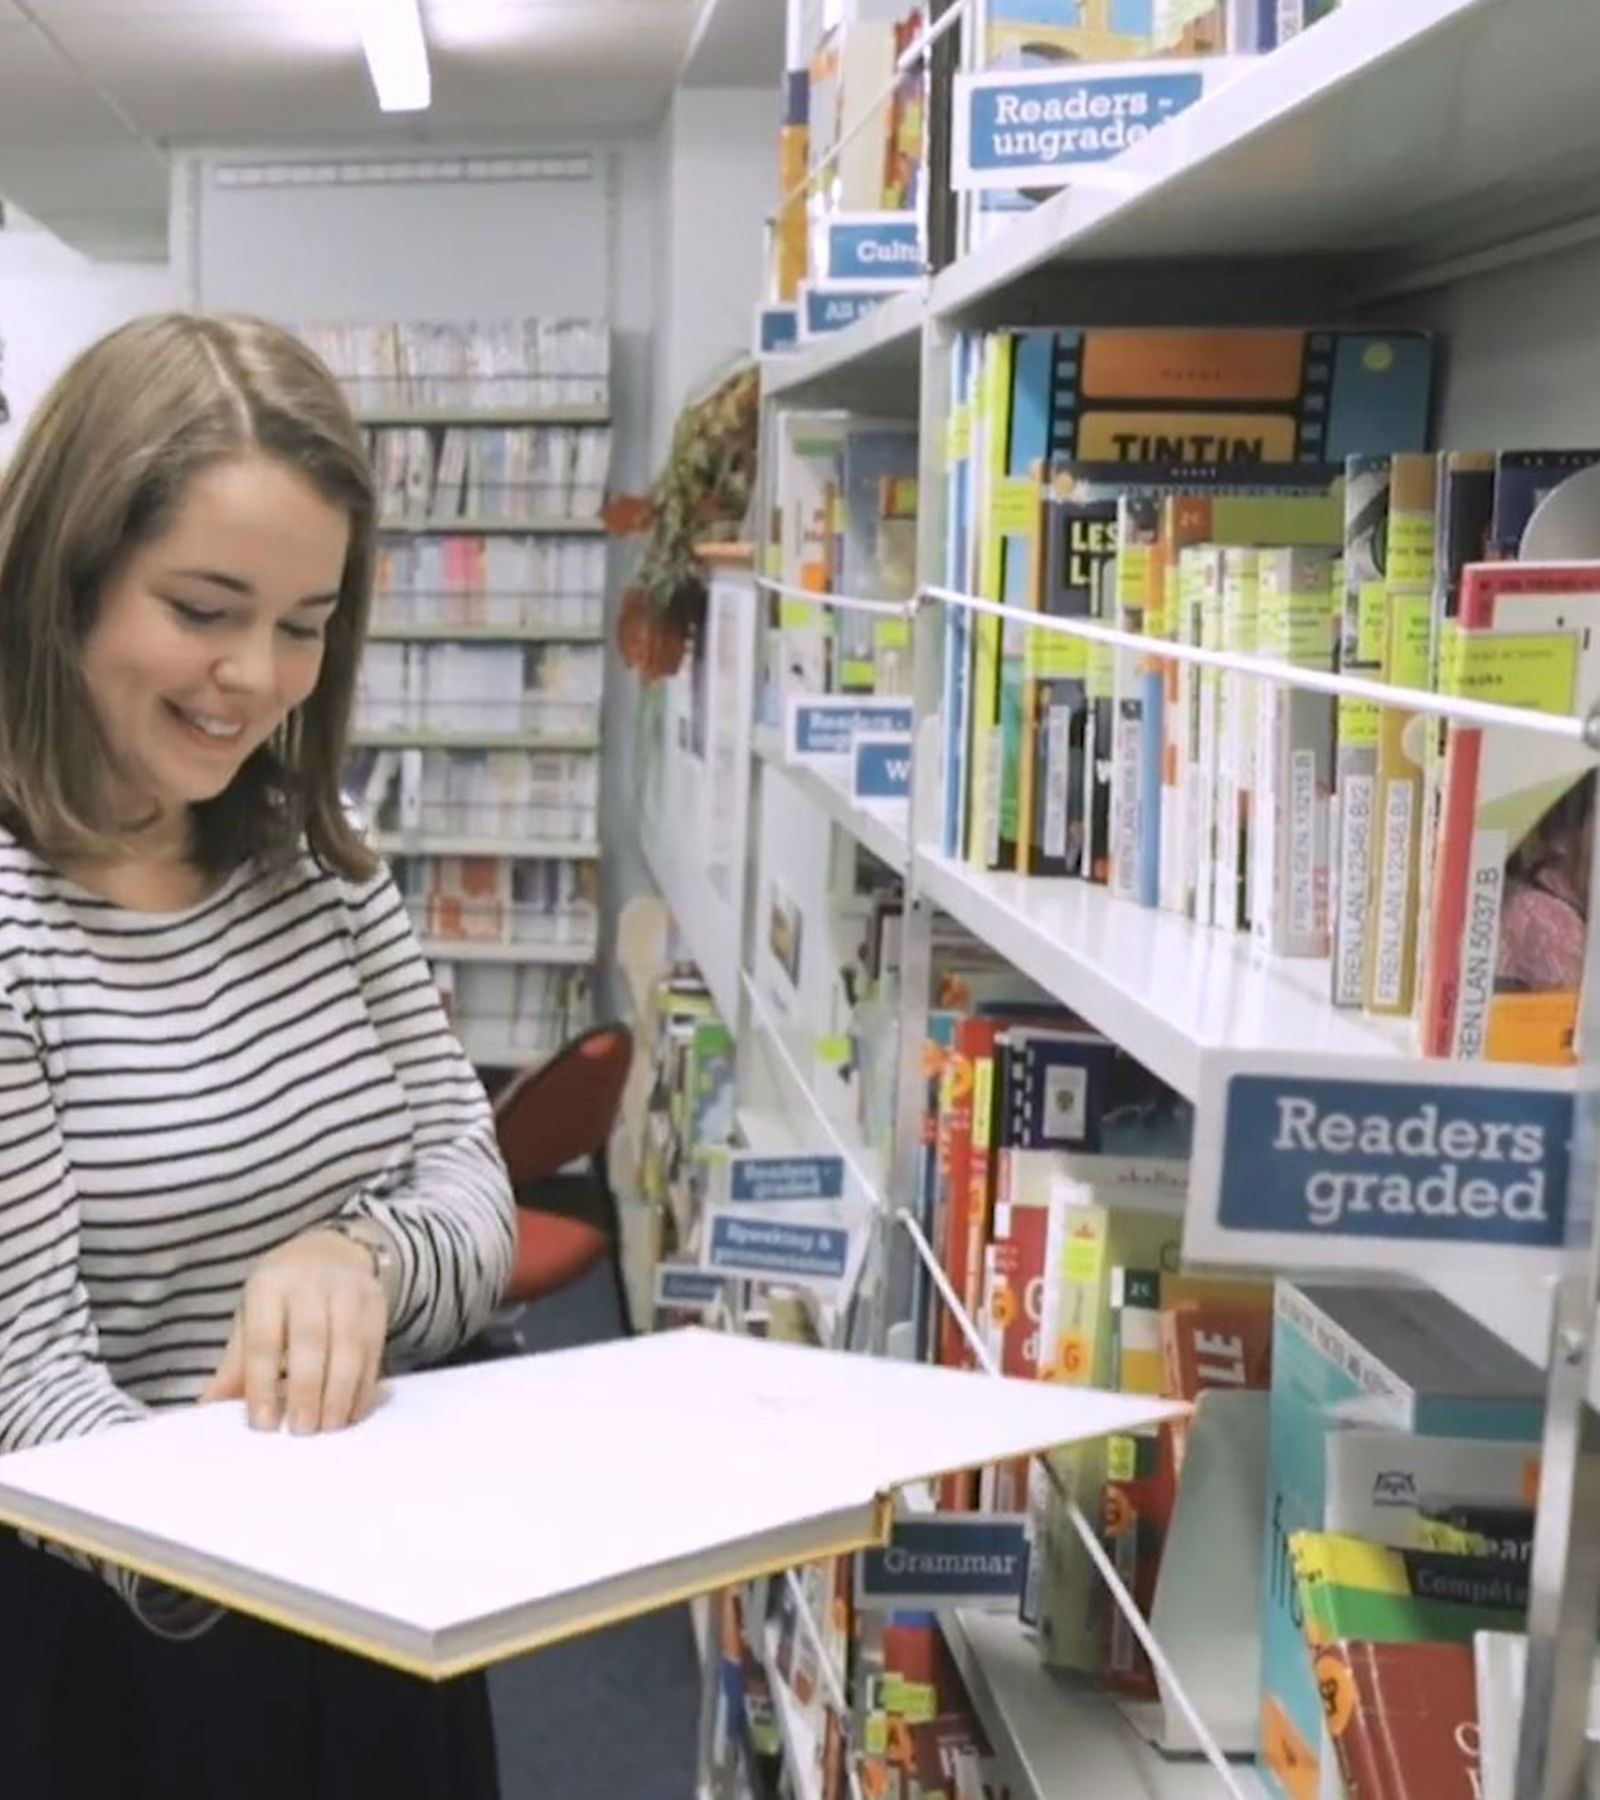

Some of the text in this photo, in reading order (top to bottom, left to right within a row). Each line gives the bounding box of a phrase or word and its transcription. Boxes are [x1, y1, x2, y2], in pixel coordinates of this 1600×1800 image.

[994, 89, 1148, 126] Readers
[1111, 433, 1266, 463] TINTIN
[1458, 1010, 1484, 1062] REN
[1272, 1096, 1545, 1164] Readers
[1304, 1165, 1549, 1226] graded
[883, 1548, 1018, 1577] Grammar
